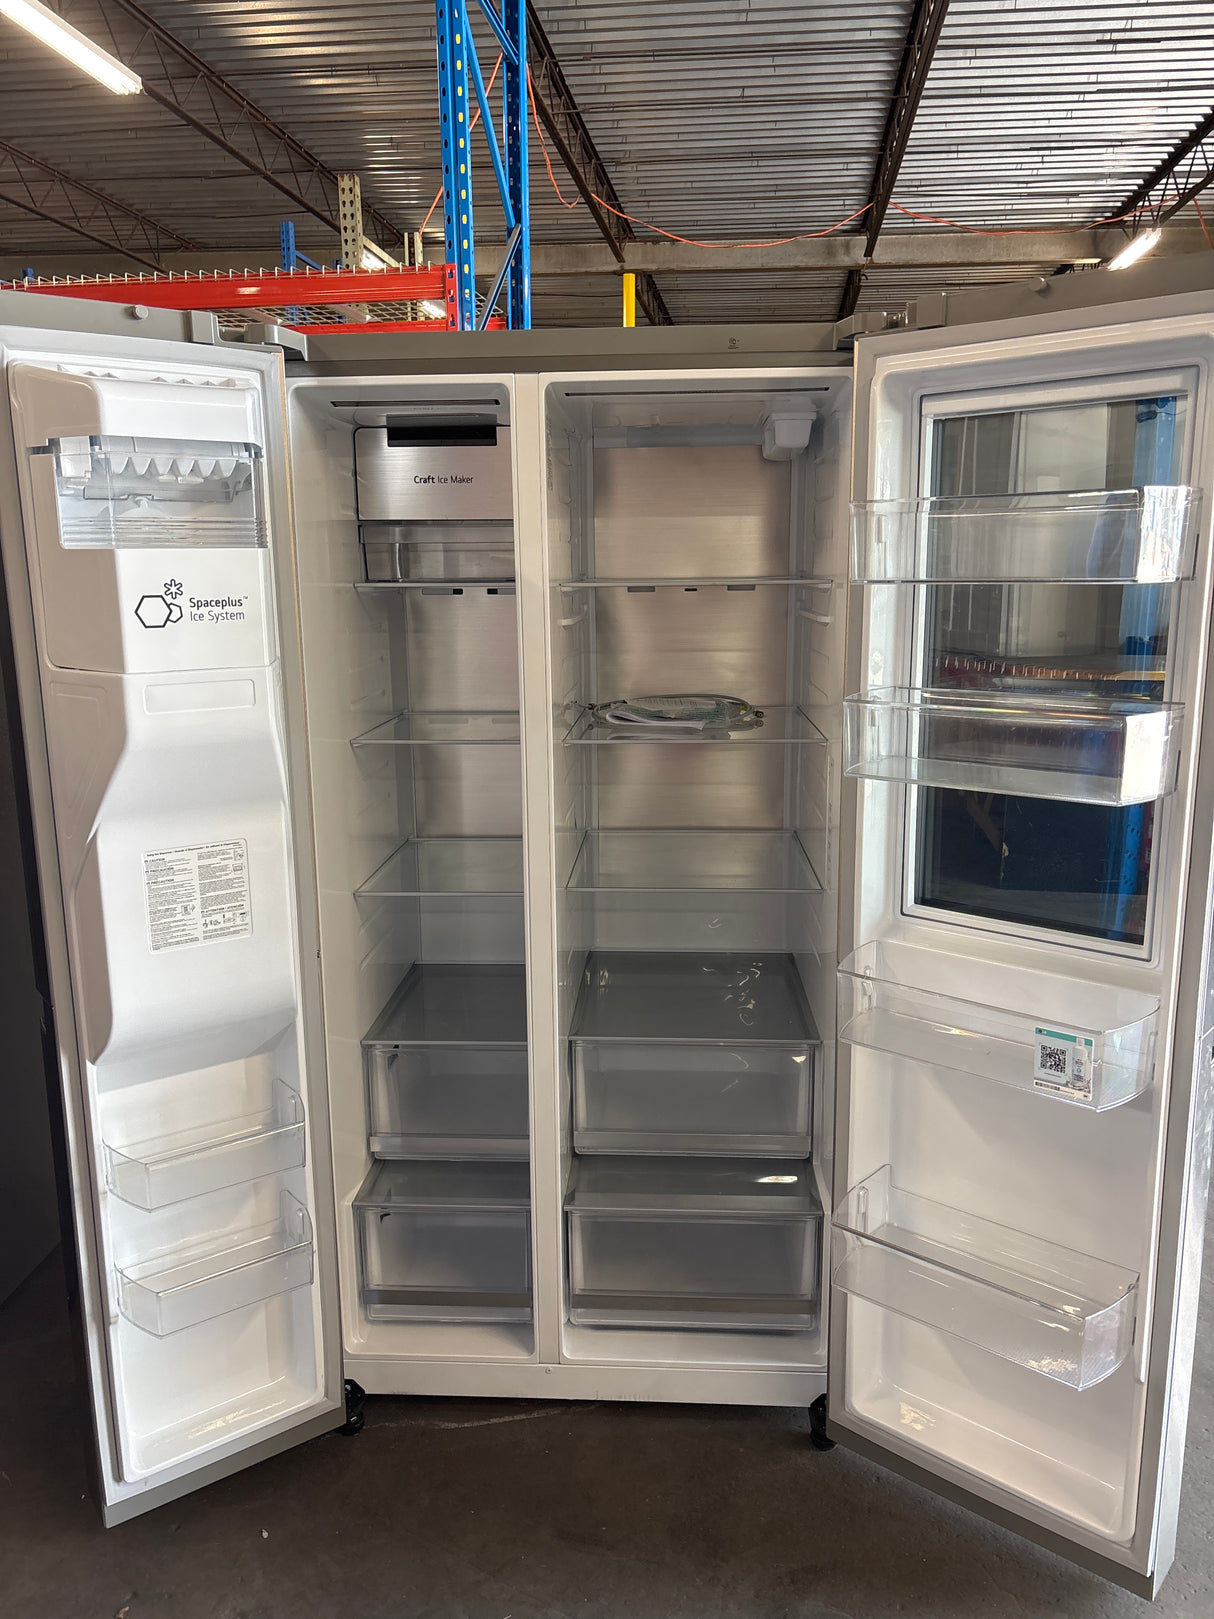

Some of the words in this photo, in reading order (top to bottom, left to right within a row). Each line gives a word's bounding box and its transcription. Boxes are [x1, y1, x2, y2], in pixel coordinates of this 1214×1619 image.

[413, 475, 435, 484] Craft
[437, 475, 449, 484] Ice
[450, 475, 474, 484] Maker
[190, 611, 204, 621] Ice
[207, 610, 245, 623] System
